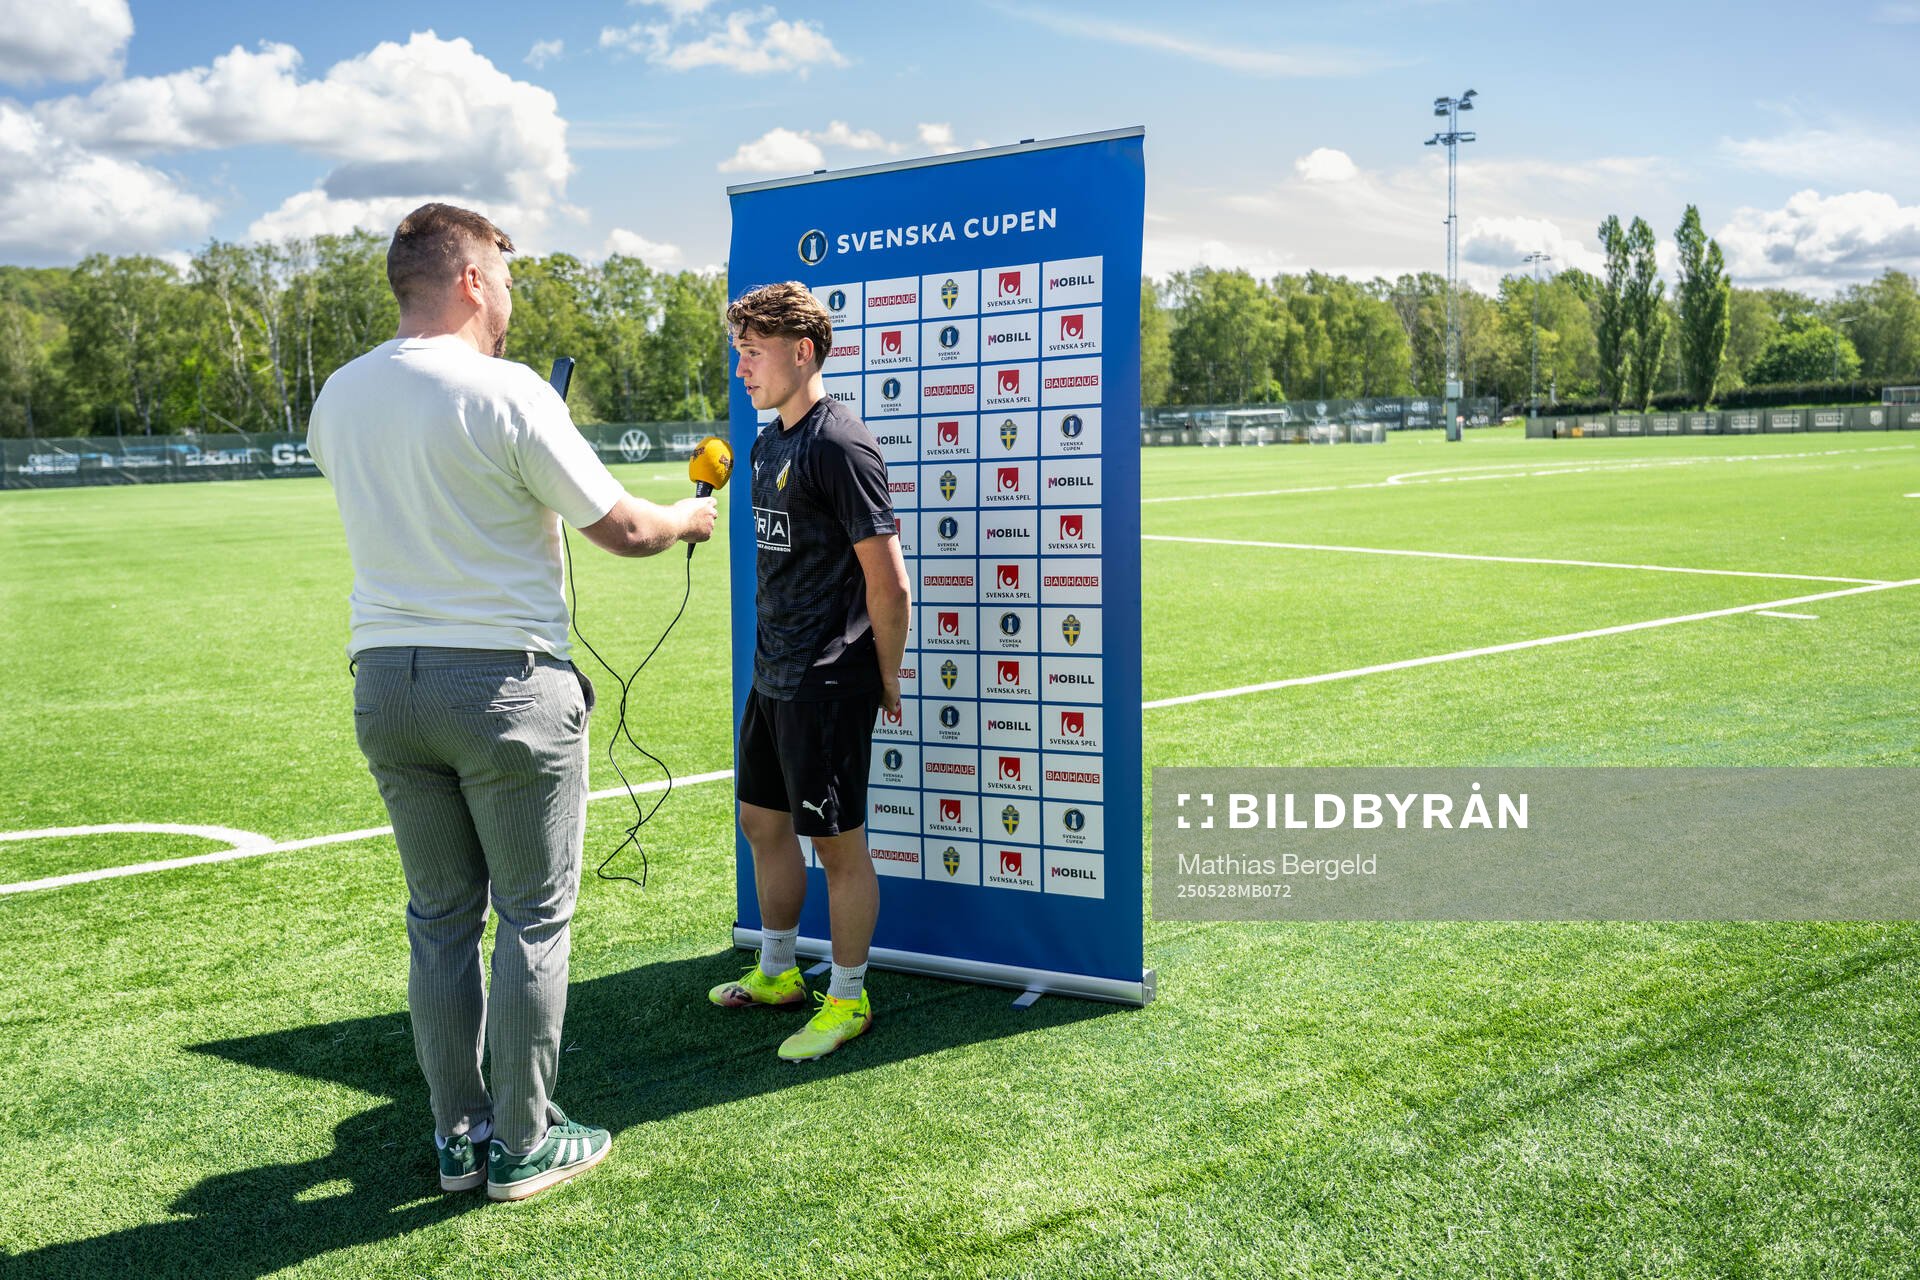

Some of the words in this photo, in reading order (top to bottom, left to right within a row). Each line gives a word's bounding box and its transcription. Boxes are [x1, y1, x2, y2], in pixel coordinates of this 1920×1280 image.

[836, 221, 955, 255] SVENSKA
[963, 208, 1057, 240] CUPEN
[1050, 275, 1095, 290] MOBILL
[868, 293, 917, 307] BAUHAUS
[987, 299, 1015, 308] SVENSKA
[1017, 297, 1033, 305] SPEL
[988, 332, 1031, 346] MOBILL
[1049, 343, 1078, 351] SVENSKA
[1080, 341, 1096, 349] SPEL
[871, 357, 897, 366] SVENSKA
[898, 356, 912, 364] SPEL
[1044, 375, 1099, 389] BAUHAUS
[924, 384, 975, 397] BAUHAUS
[986, 397, 1014, 405] SVENSKA
[927, 448, 954, 456] SVENSKA
[888, 482, 916, 492] HAUS
[1048, 477, 1094, 488] MOBILL
[986, 528, 1030, 540] MOBILL
[924, 576, 974, 586] BAUHAUS
[1044, 576, 1098, 586] BAUHAUS
[1049, 674, 1094, 685] MOBILL
[988, 720, 1031, 731] MOBILL
[926, 762, 975, 775] BAUHAUS
[1046, 771, 1100, 784] BAUHAUS
[988, 782, 1016, 790] SVENSKA
[875, 804, 914, 816] MOBILL
[871, 849, 919, 862] BAUHAUS
[1052, 867, 1096, 880] MOBILL
[990, 876, 1017, 884] SVENSKA
